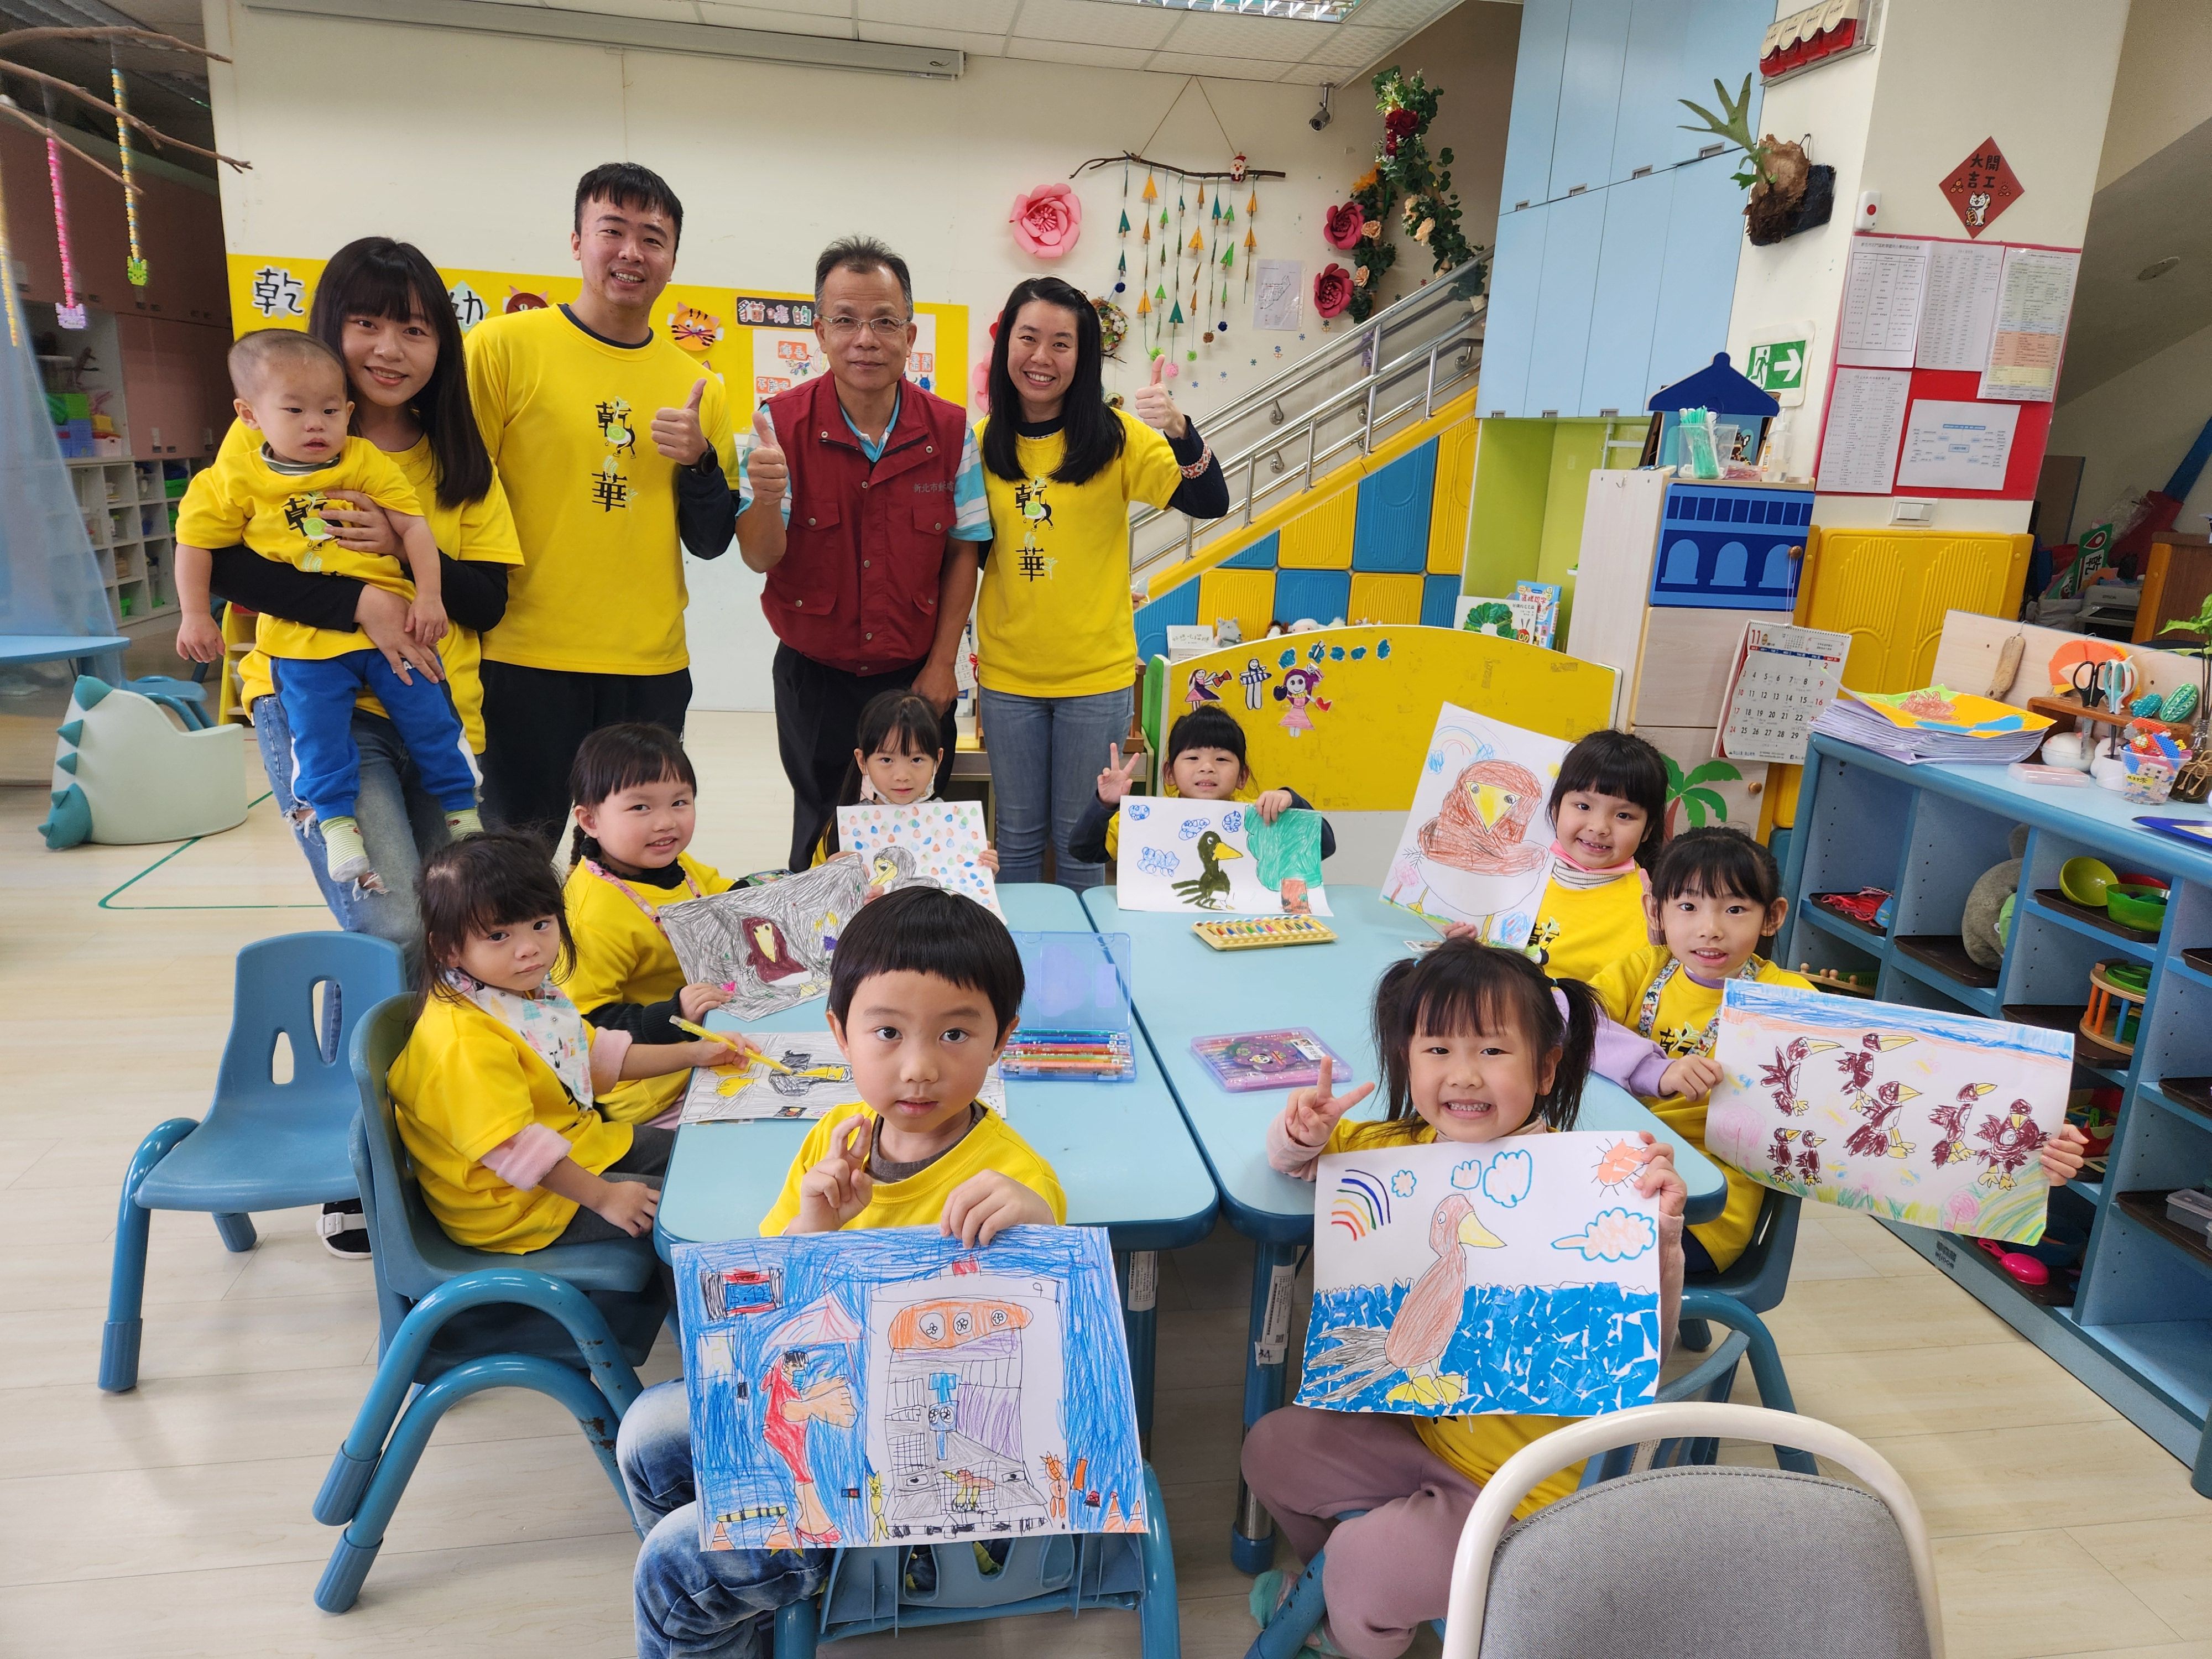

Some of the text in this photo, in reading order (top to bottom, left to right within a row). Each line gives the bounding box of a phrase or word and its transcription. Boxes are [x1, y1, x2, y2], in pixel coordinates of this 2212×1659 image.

[1983, 155, 2001, 188] 開工
[255, 268, 303, 314] 乾
[1752, 629, 1761, 645] 11
